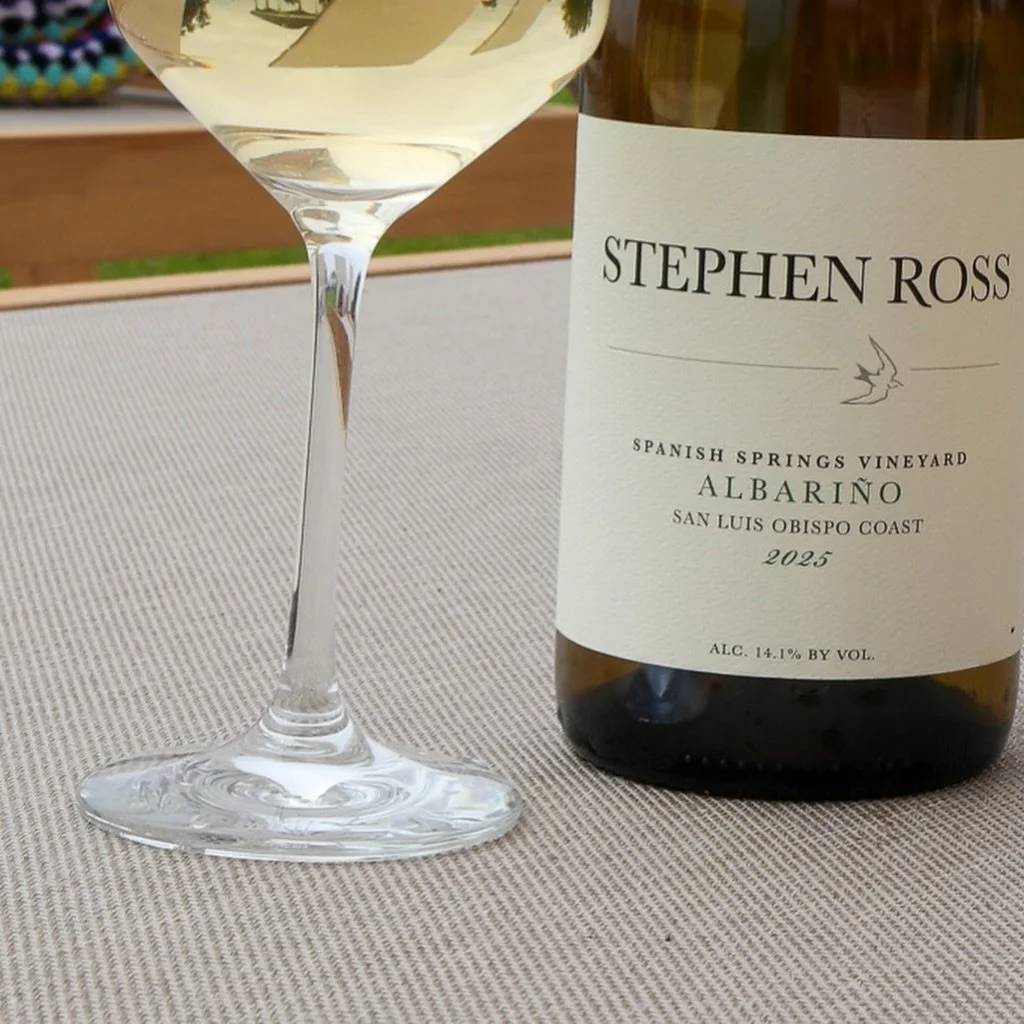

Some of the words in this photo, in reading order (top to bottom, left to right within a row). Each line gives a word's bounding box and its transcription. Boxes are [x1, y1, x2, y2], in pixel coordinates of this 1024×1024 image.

[602, 234, 872, 305] STEPHEN
[886, 253, 1012, 309] ROSS
[632, 437, 724, 464] SPANISH
[736, 449, 845, 470] SPRINGS
[858, 451, 968, 470] VINEYARD
[697, 473, 903, 506] ALBARIÑO
[672, 508, 711, 528] SAN
[717, 513, 764, 533] LUIS
[771, 517, 851, 536] OBISPO
[858, 518, 925, 536] COAST
[761, 548, 834, 569] 2025
[709, 642, 748, 658] ALC.
[754, 646, 802, 661] 14.1%
[808, 648, 831, 662] BY
[837, 648, 876, 662] VOL.
